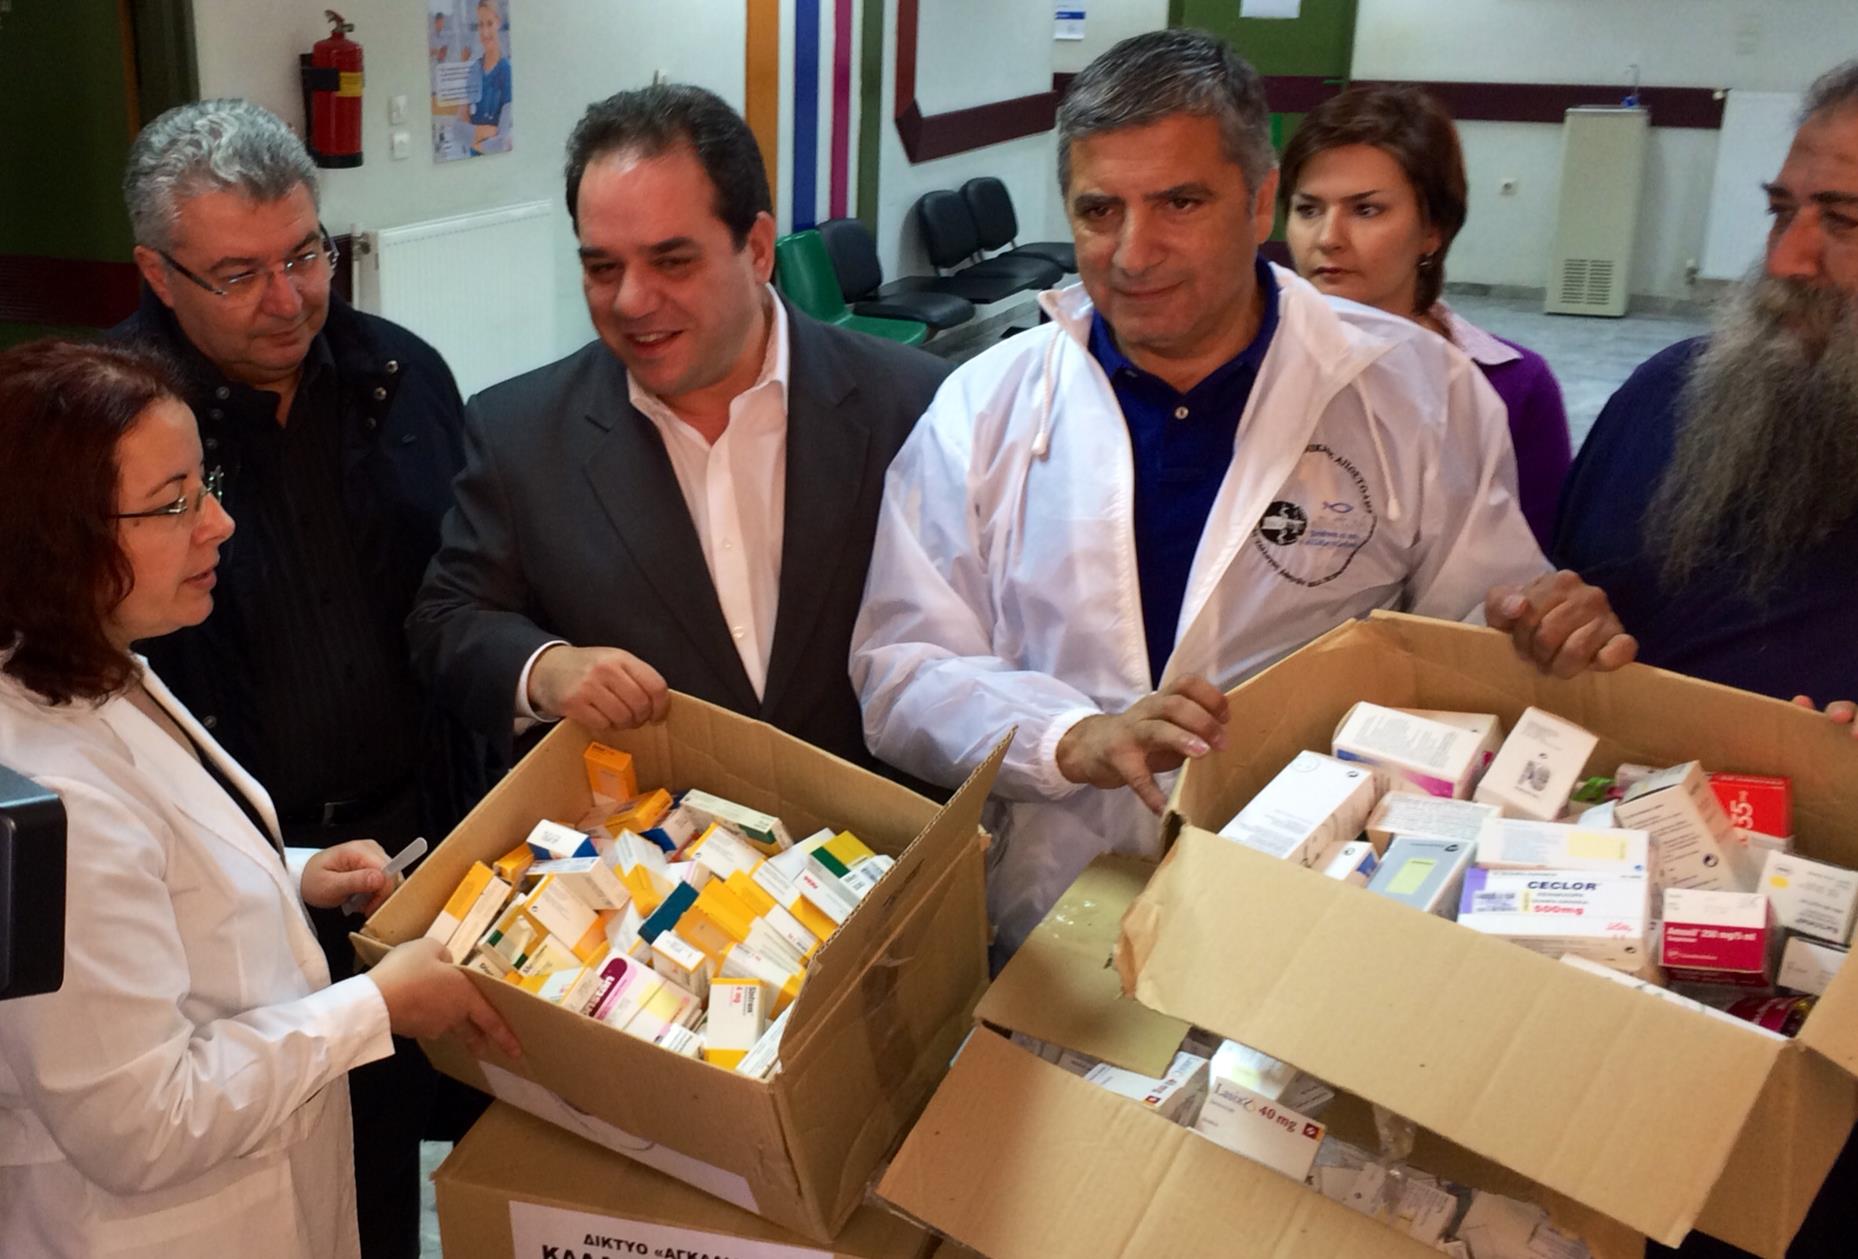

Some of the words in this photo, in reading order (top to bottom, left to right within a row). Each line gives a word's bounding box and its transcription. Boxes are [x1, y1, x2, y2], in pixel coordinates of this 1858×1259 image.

[1527, 880, 1598, 891] CECLOR
[1534, 904, 1585, 916] 500mg
[1259, 1105, 1276, 1120] 40
[1277, 1115, 1298, 1133] mg
[583, 1233, 648, 1255] ΔΙΚΤΥΟ
